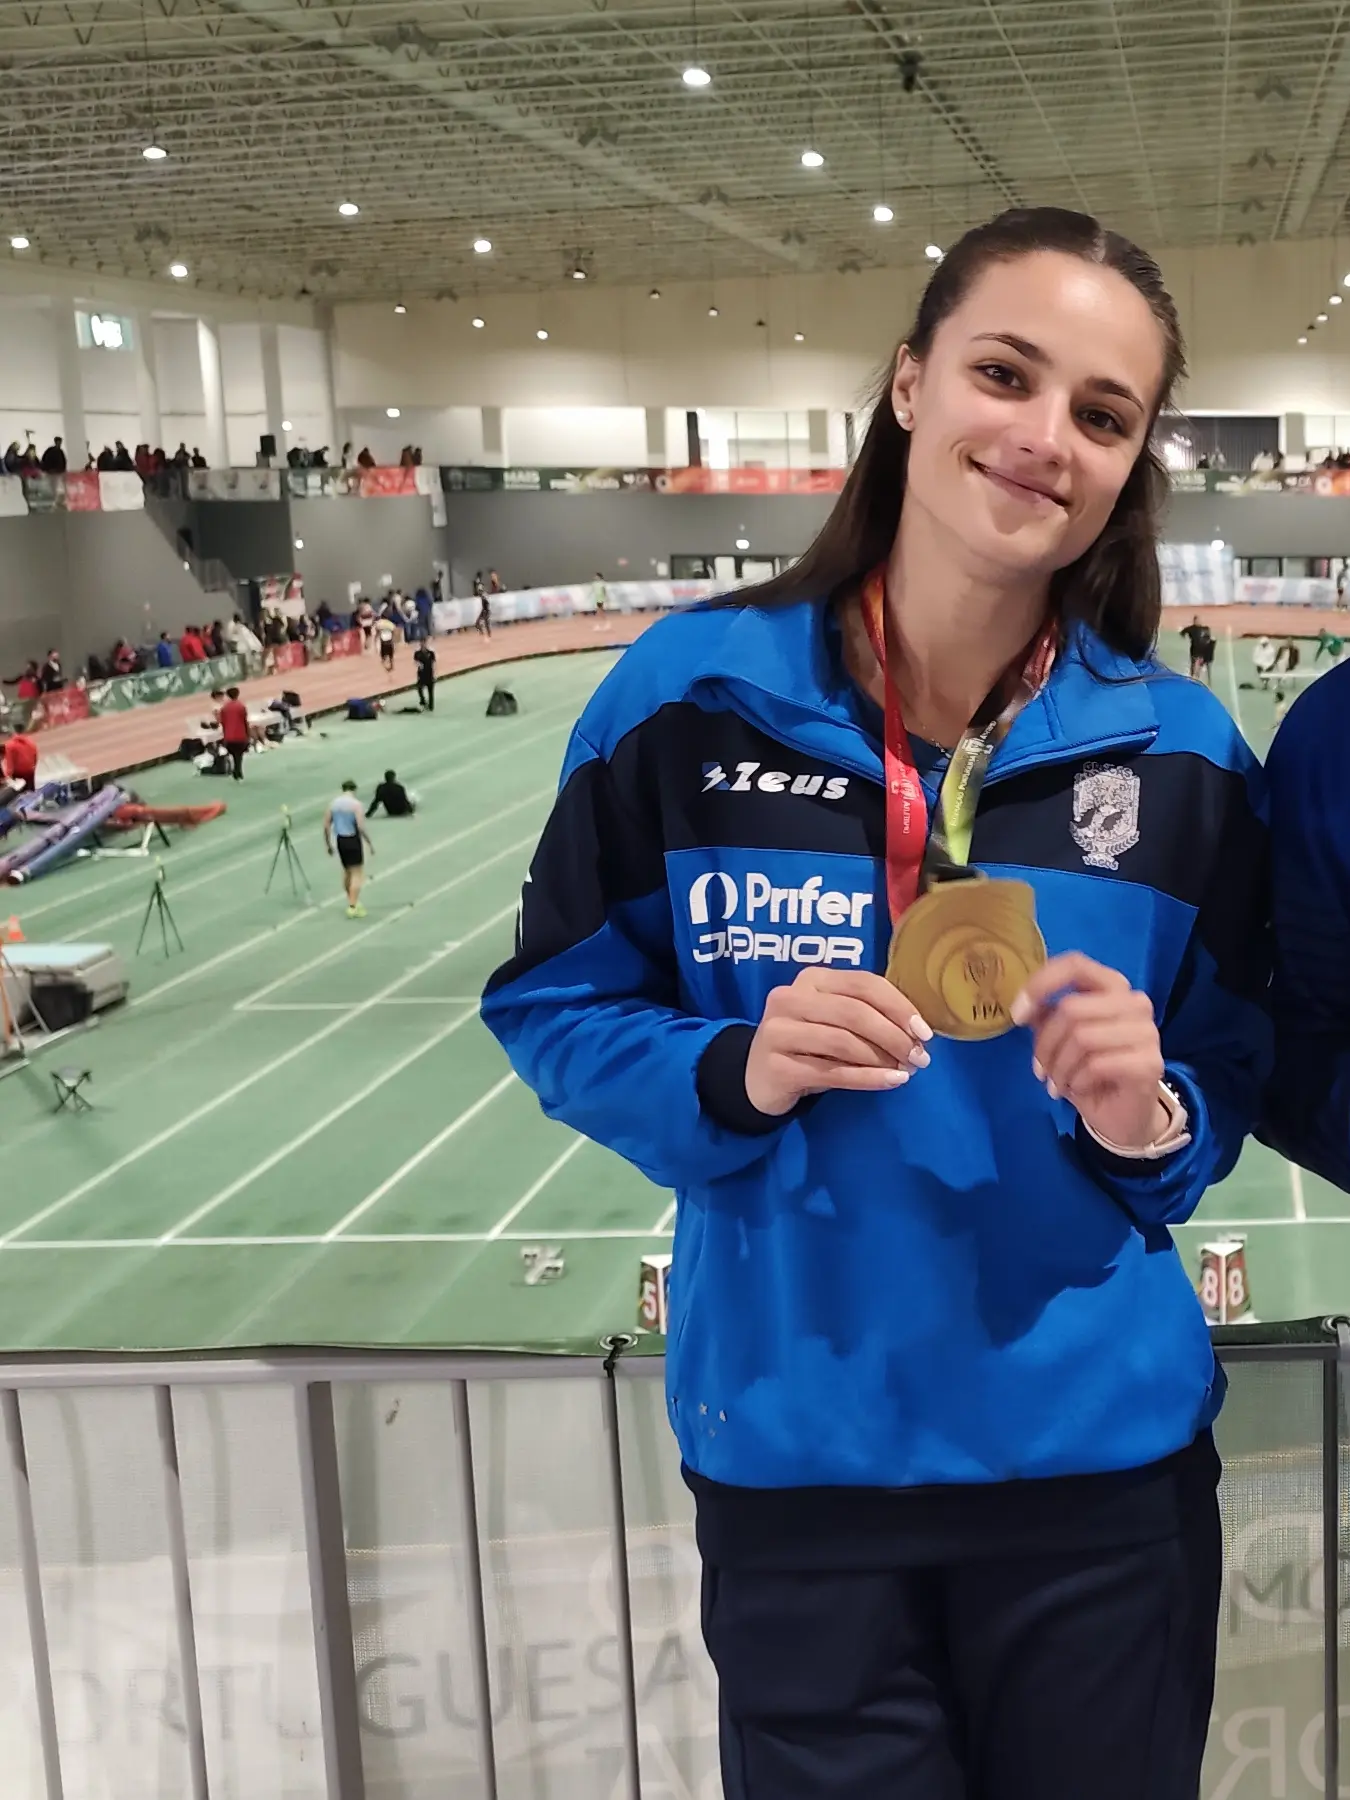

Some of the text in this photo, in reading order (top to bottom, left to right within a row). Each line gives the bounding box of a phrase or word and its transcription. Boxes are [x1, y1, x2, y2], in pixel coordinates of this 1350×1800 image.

[729, 762, 849, 800] Zeus
[746, 872, 873, 928] Prifer
[642, 1280, 657, 1321] 5
[1202, 1266, 1218, 1307] 8
[1228, 1267, 1245, 1307] 8
